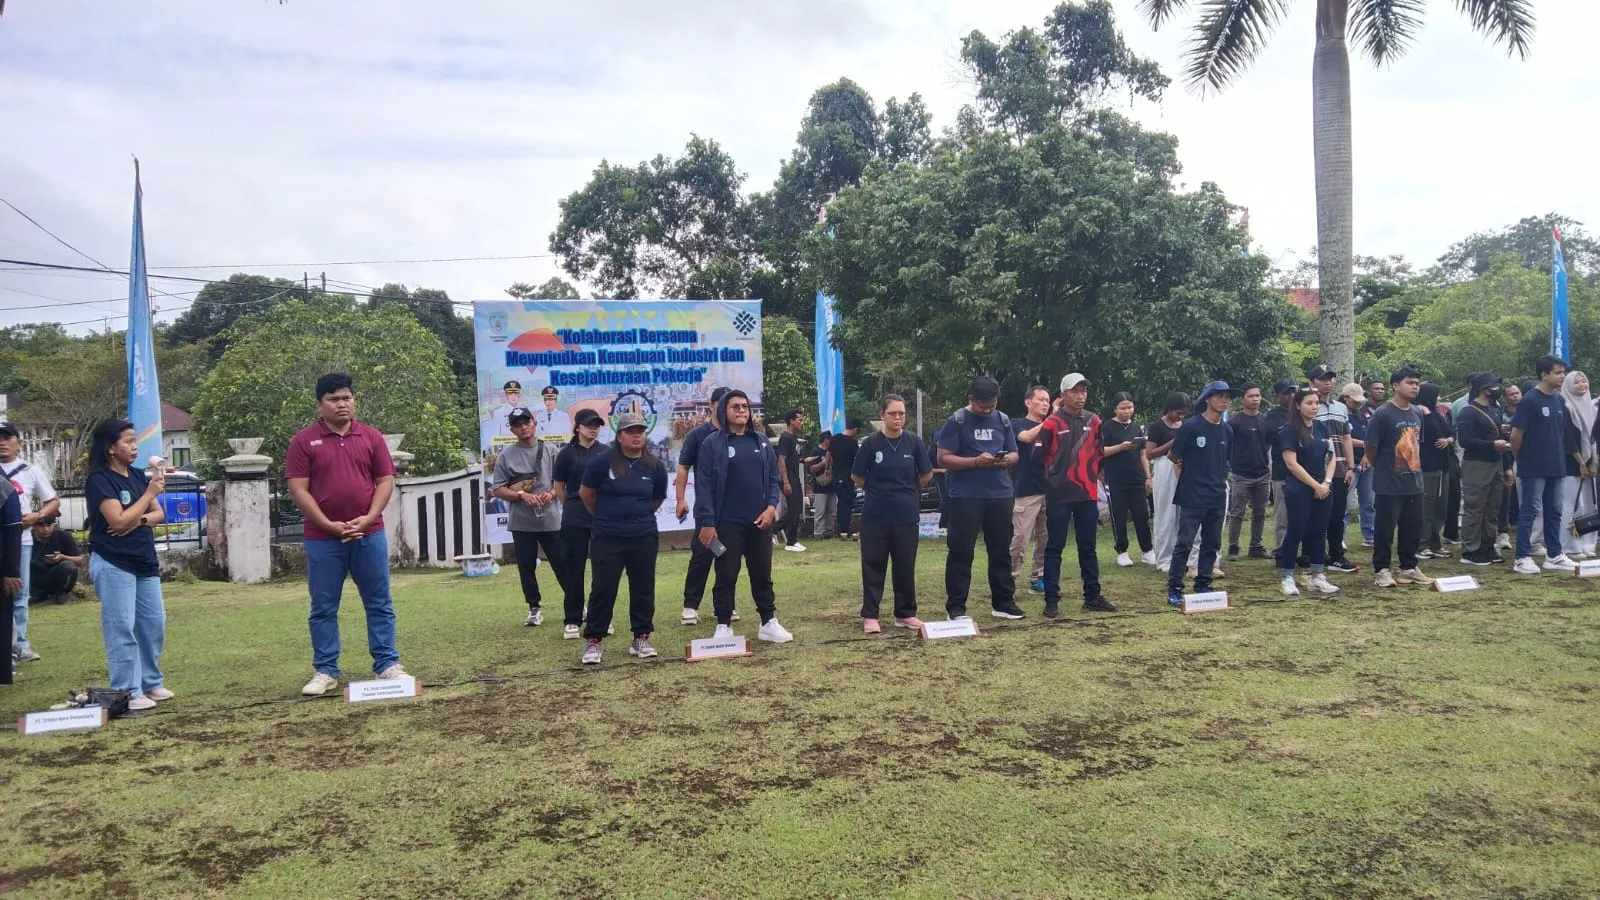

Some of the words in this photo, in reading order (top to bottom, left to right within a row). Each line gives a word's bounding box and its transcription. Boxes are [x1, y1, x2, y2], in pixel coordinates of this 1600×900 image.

[556, 328, 638, 345] "Kolaborasi
[638, 327, 698, 344] Bersama
[505, 350, 597, 367] Mewujudkan
[597, 348, 666, 365] Kemajuan
[667, 347, 719, 363] Industri
[720, 347, 745, 363] dan
[549, 369, 651, 387] Kesejahteraan
[652, 367, 707, 385] Pekerja"
[974, 428, 995, 440] CAT
